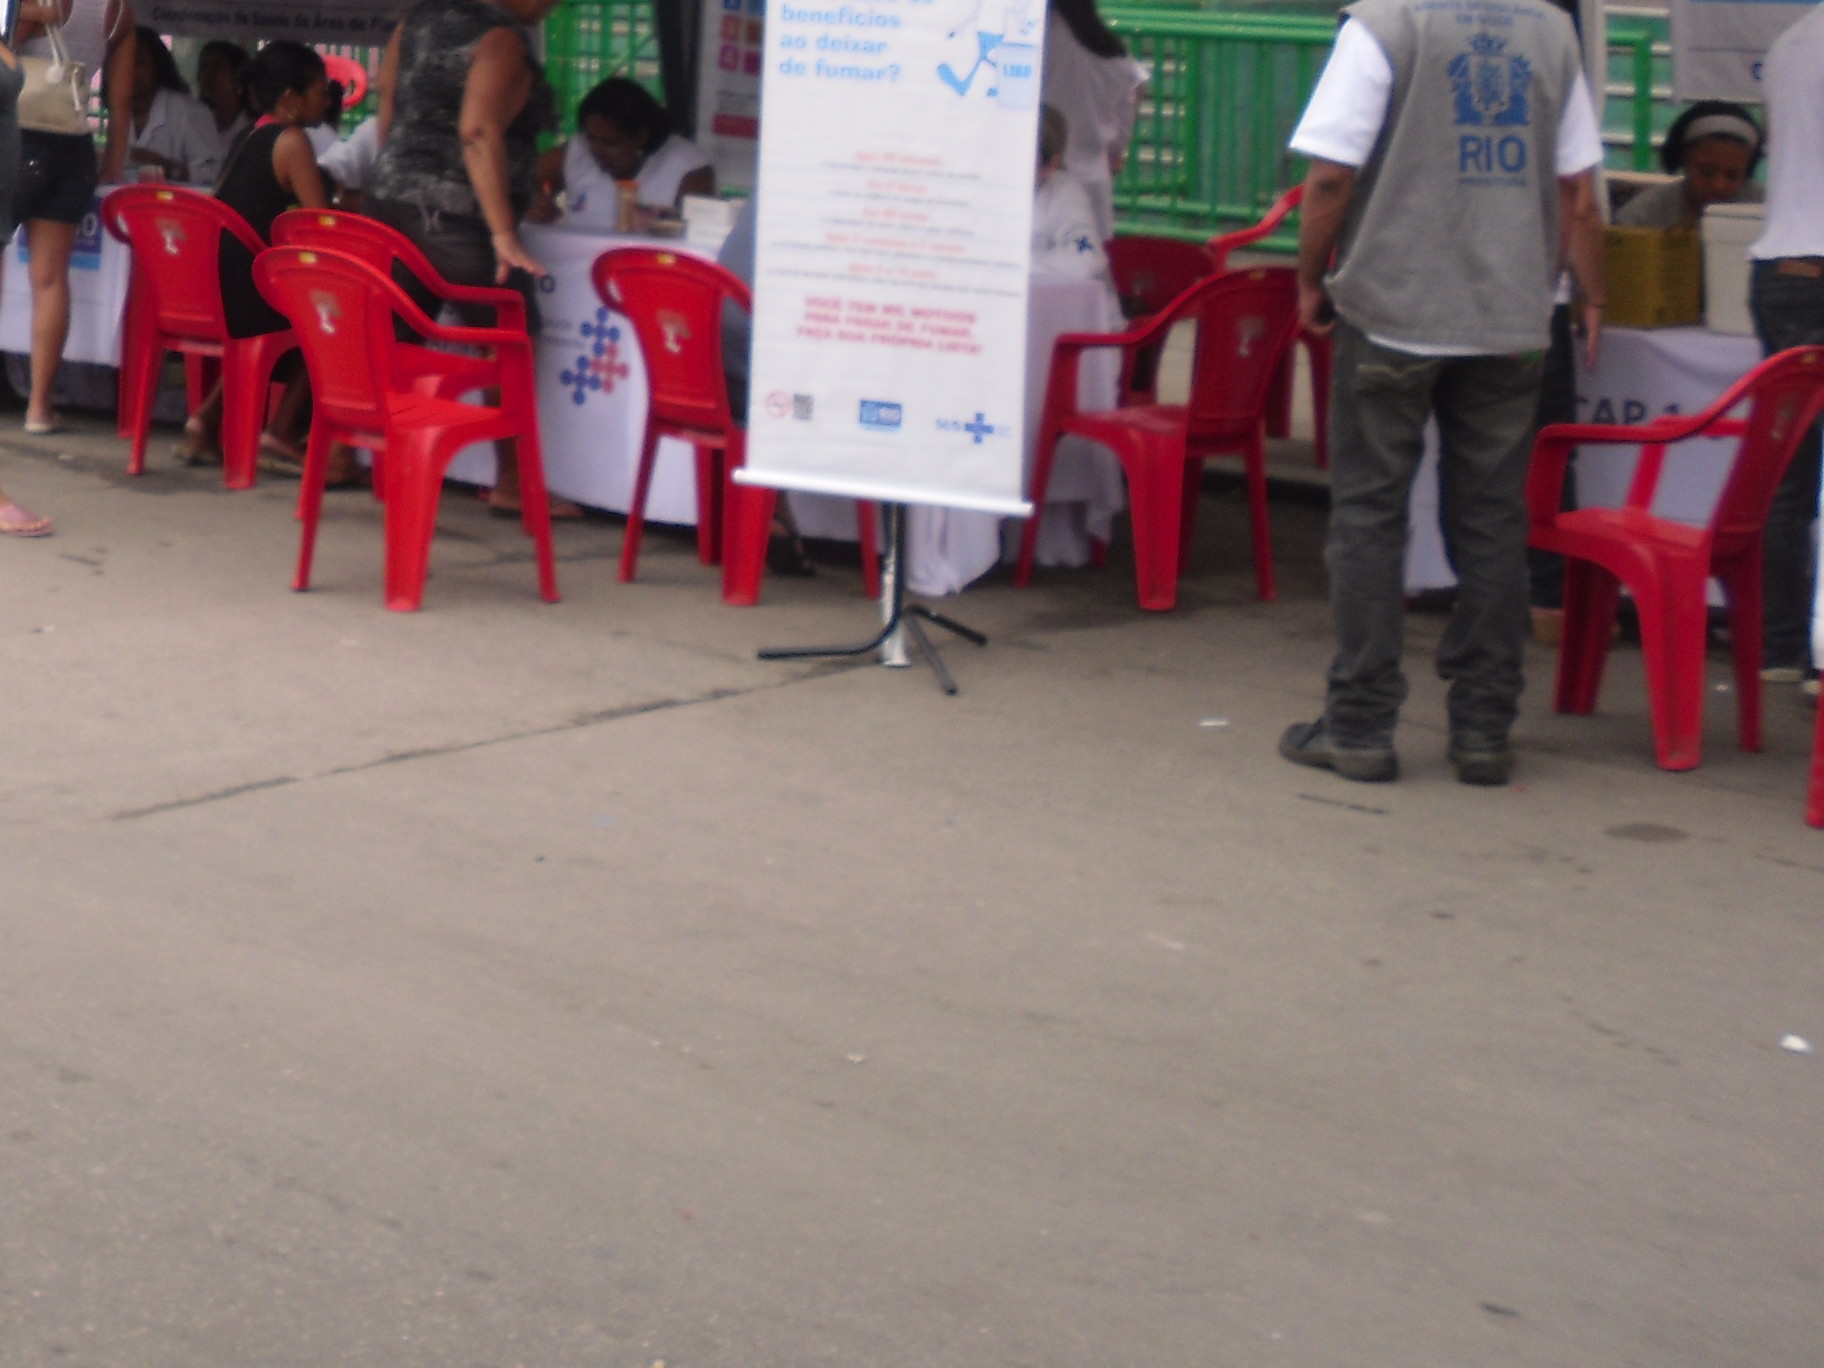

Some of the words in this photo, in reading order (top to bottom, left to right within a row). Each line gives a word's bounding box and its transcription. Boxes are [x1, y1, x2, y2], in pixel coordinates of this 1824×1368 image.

[780, 34, 807, 50] ao
[816, 33, 888, 54] deixar
[779, 57, 807, 76] de
[816, 58, 901, 83] fumar?
[1459, 134, 1527, 173] RIO
[1575, 396, 1646, 425] AP
